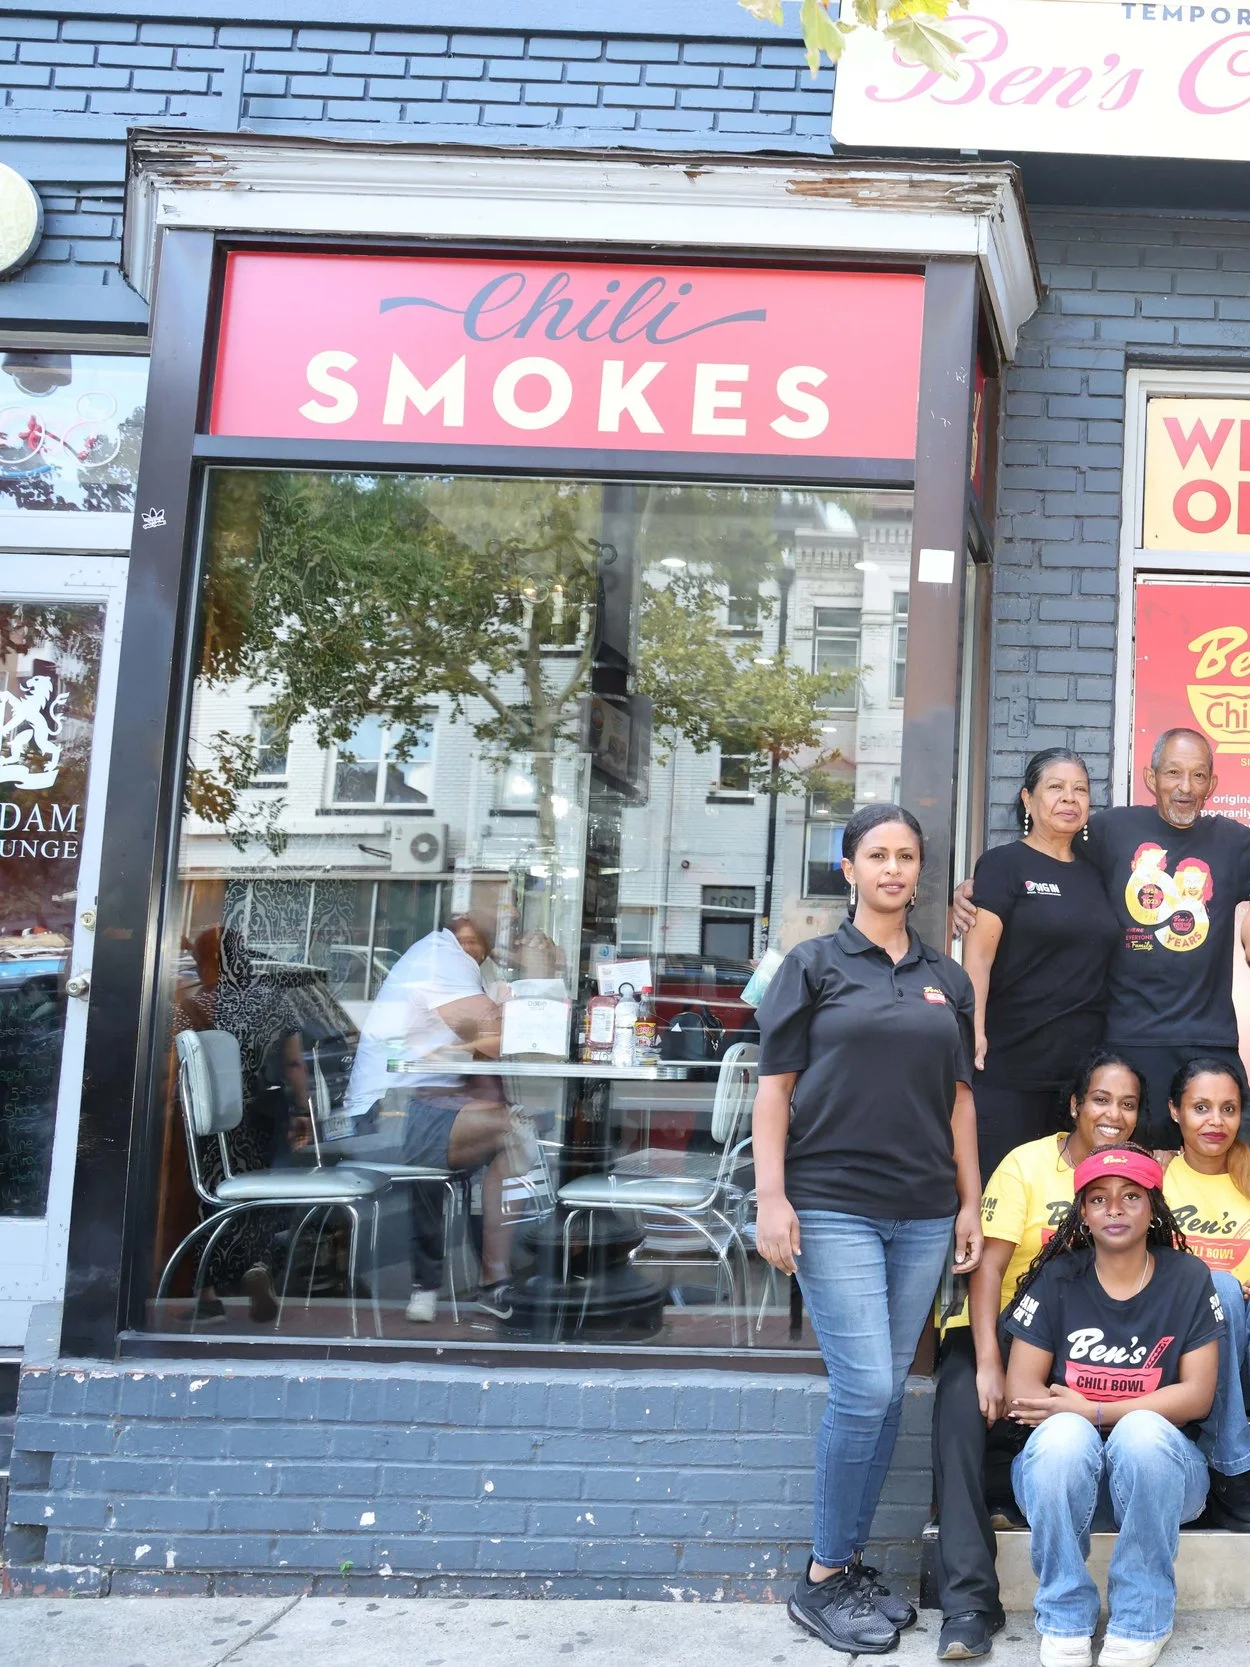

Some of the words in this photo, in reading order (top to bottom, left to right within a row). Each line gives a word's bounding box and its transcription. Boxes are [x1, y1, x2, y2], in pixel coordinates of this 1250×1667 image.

[864, 15, 1144, 111] Ben's
[380, 272, 766, 345] Chili
[298, 350, 830, 440] SMOKES
[1131, 941, 1154, 952] Family
[1166, 931, 1203, 948] YEARS
[1169, 1204, 1237, 1235] Ben's
[1206, 1247, 1236, 1261] BOWL
[1066, 1327, 1147, 1365] Ben's
[1076, 1375, 1107, 1391] CHILI
[1111, 1379, 1146, 1393] BOWL
